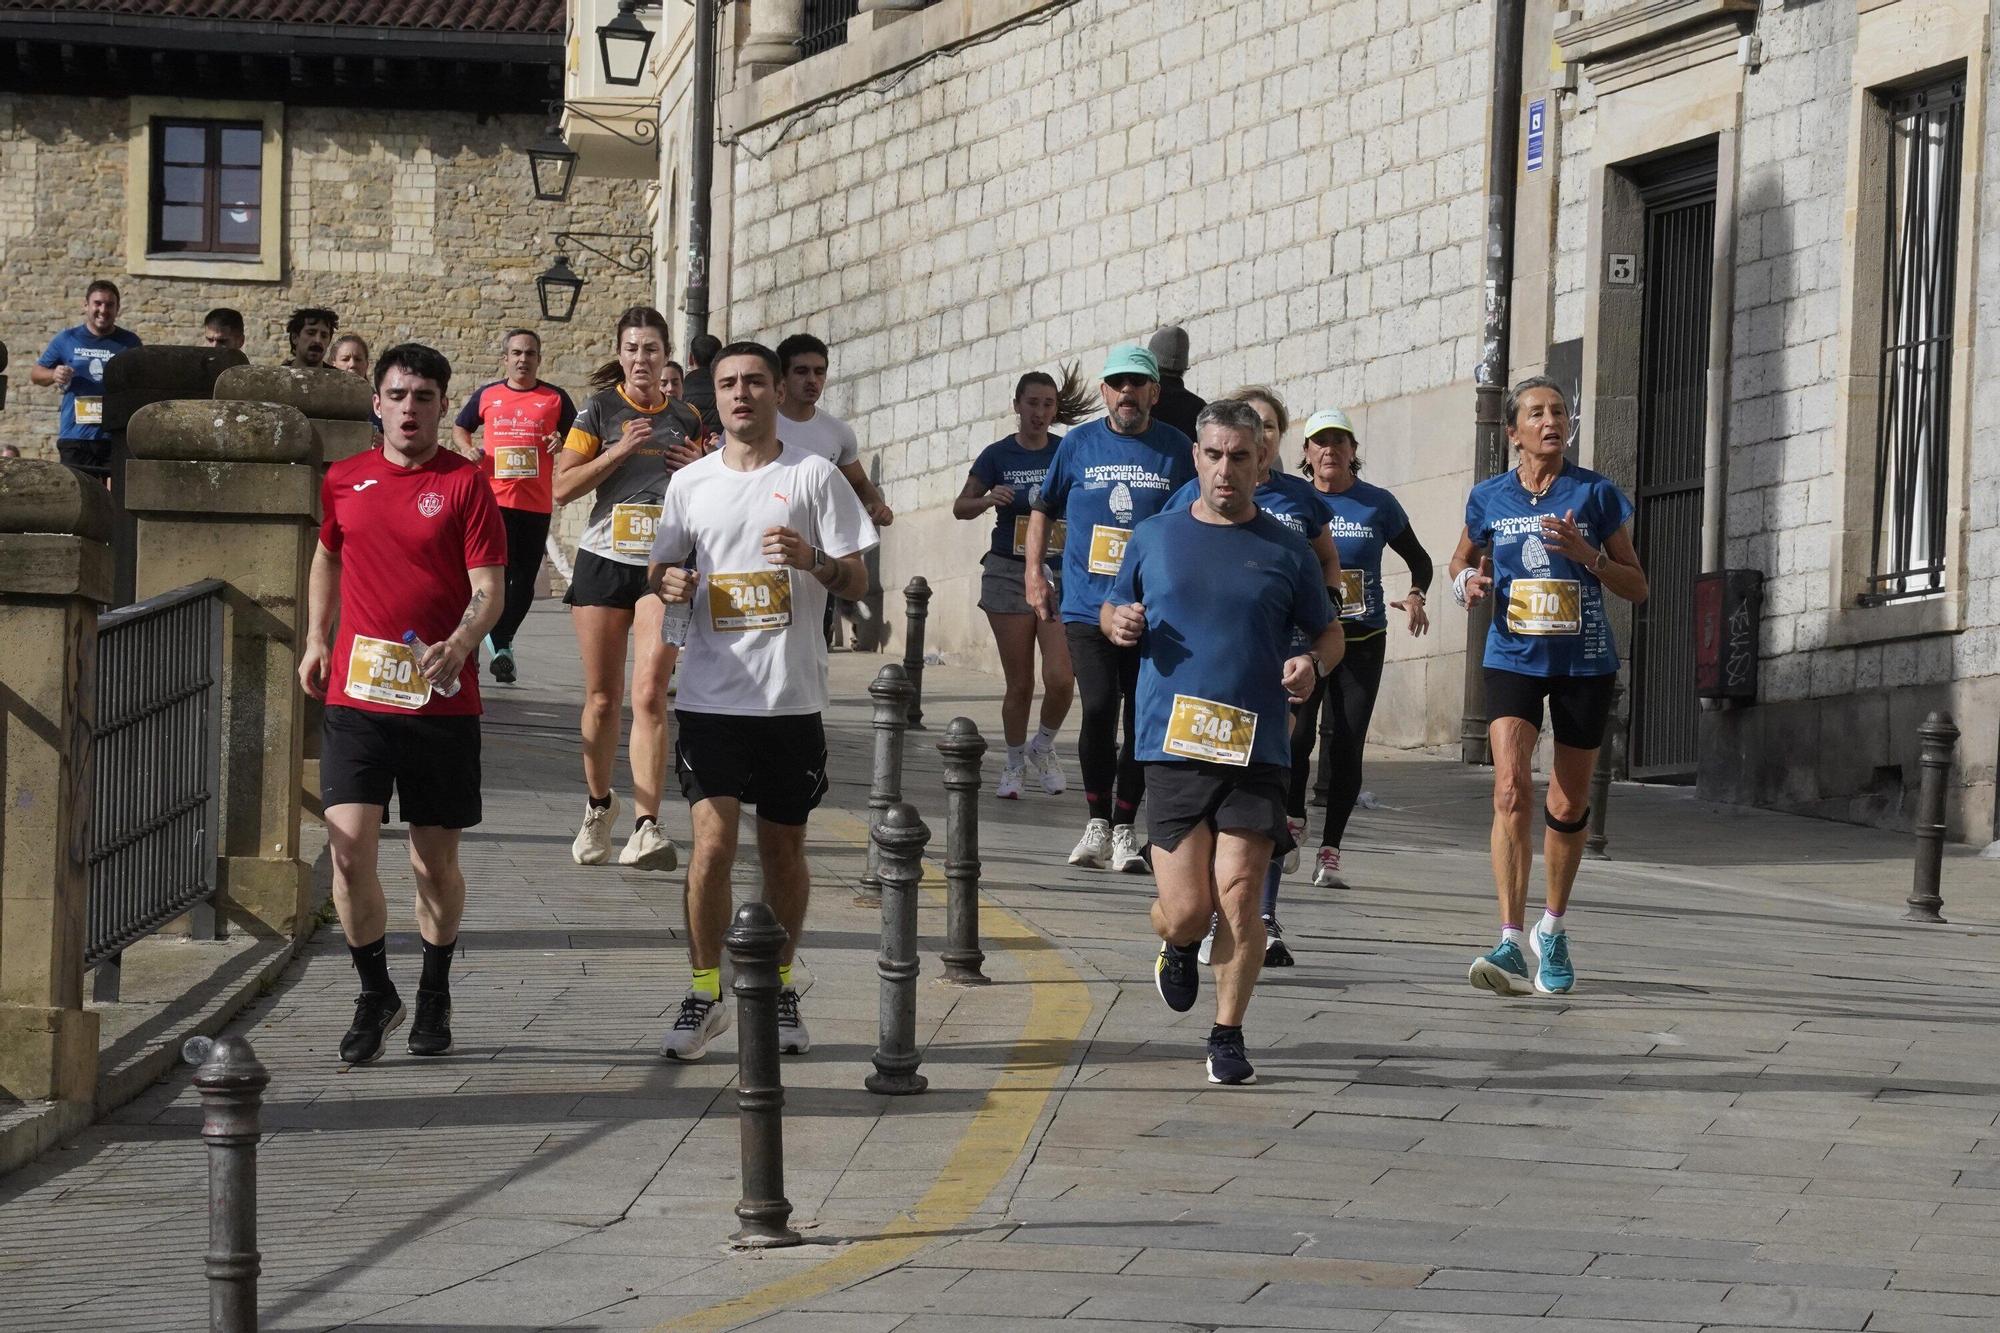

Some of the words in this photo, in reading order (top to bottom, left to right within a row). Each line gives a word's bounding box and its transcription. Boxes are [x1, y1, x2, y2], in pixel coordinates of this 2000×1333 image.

[1614, 258, 1630, 279] 3
[506, 454, 527, 466] 461
[1094, 465, 1144, 473] CONQUISTA
[1014, 474, 1046, 484] ALMEN
[1096, 471, 1160, 482] ALMENDRA
[1130, 481, 1170, 491] KONKISTA
[1329, 521, 1362, 531] NDRA
[1491, 520, 1501, 529] LA
[1331, 530, 1374, 538] KONKISTA
[1108, 540, 1128, 558] 37
[729, 585, 770, 609] 349
[1529, 593, 1560, 615] 170
[368, 653, 412, 684] 350
[1191, 713, 1233, 743] 348
